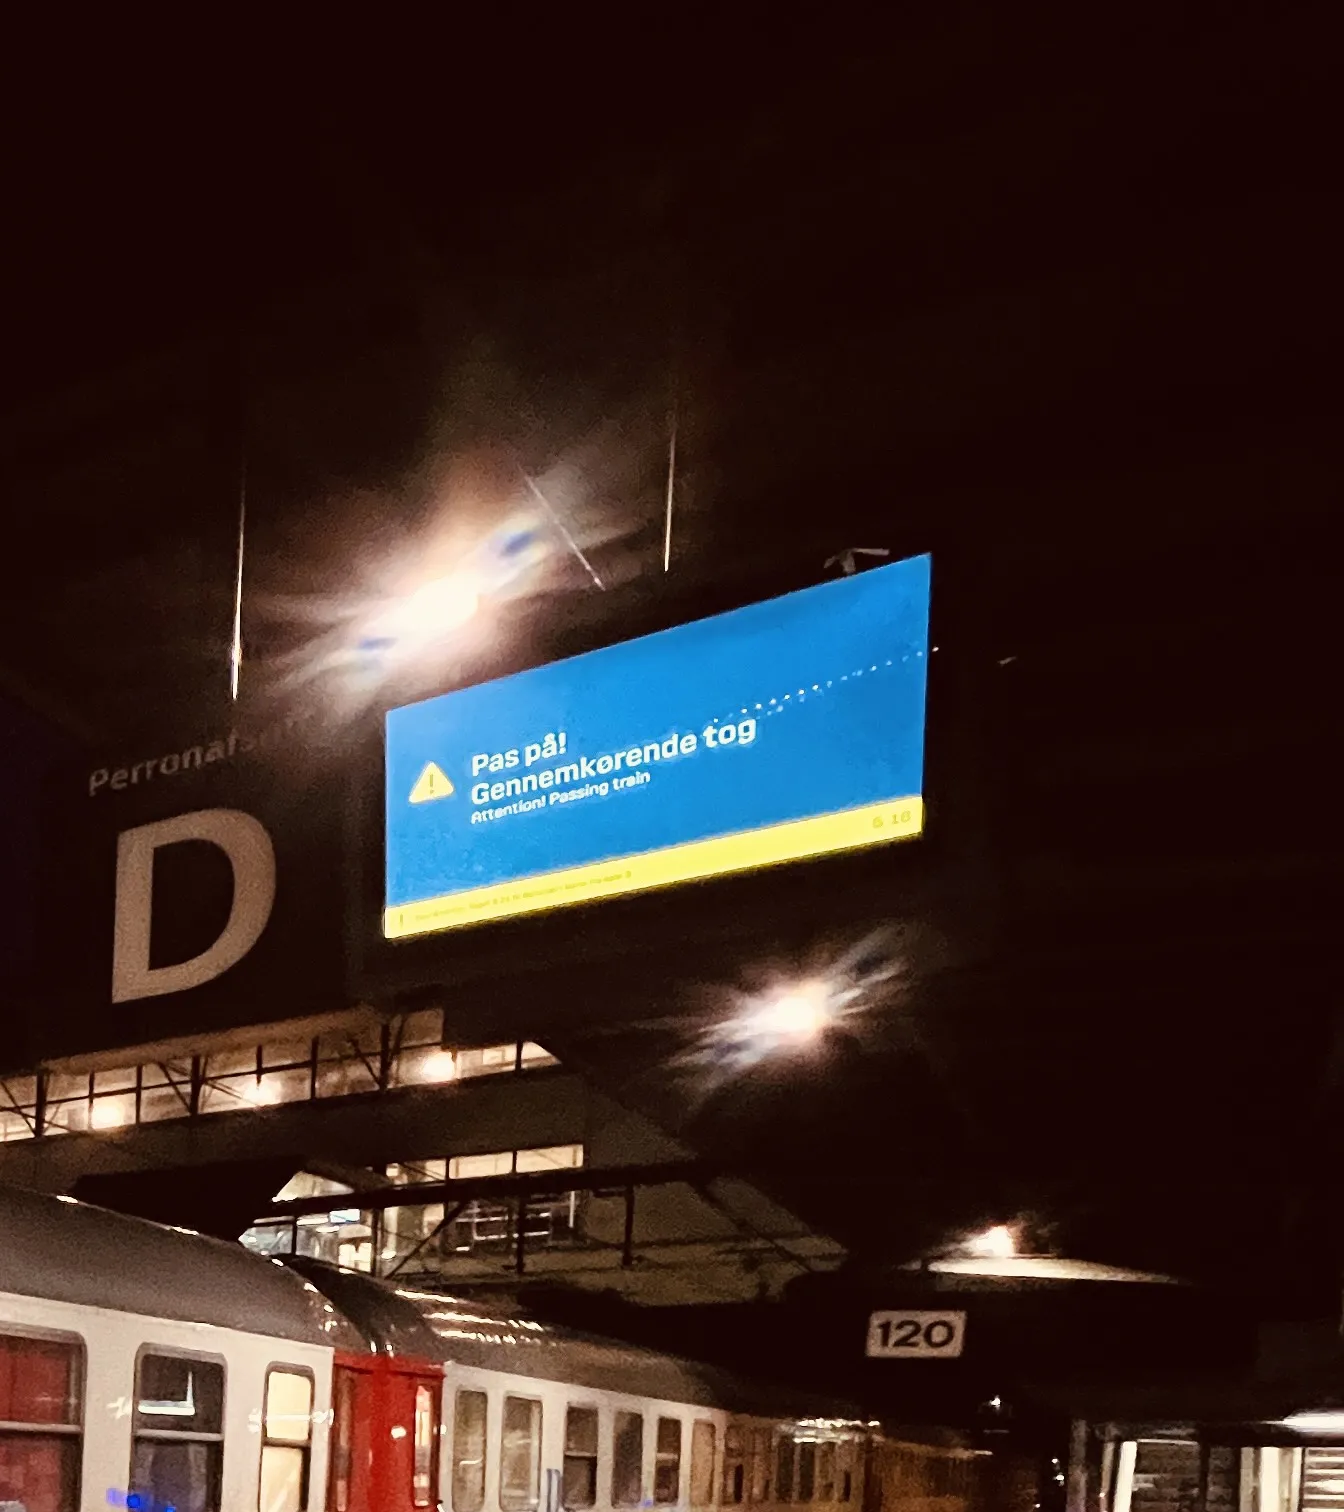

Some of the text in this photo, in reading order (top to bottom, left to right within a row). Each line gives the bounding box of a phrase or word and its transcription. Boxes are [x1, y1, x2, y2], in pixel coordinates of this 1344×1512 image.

[470, 718, 757, 805] Gennemkørende tog
[471, 732, 567, 777] Pas på!
[470, 770, 651, 824] Attention! Passing train
[112, 807, 277, 1003] D
[877, 1319, 955, 1348] 120
